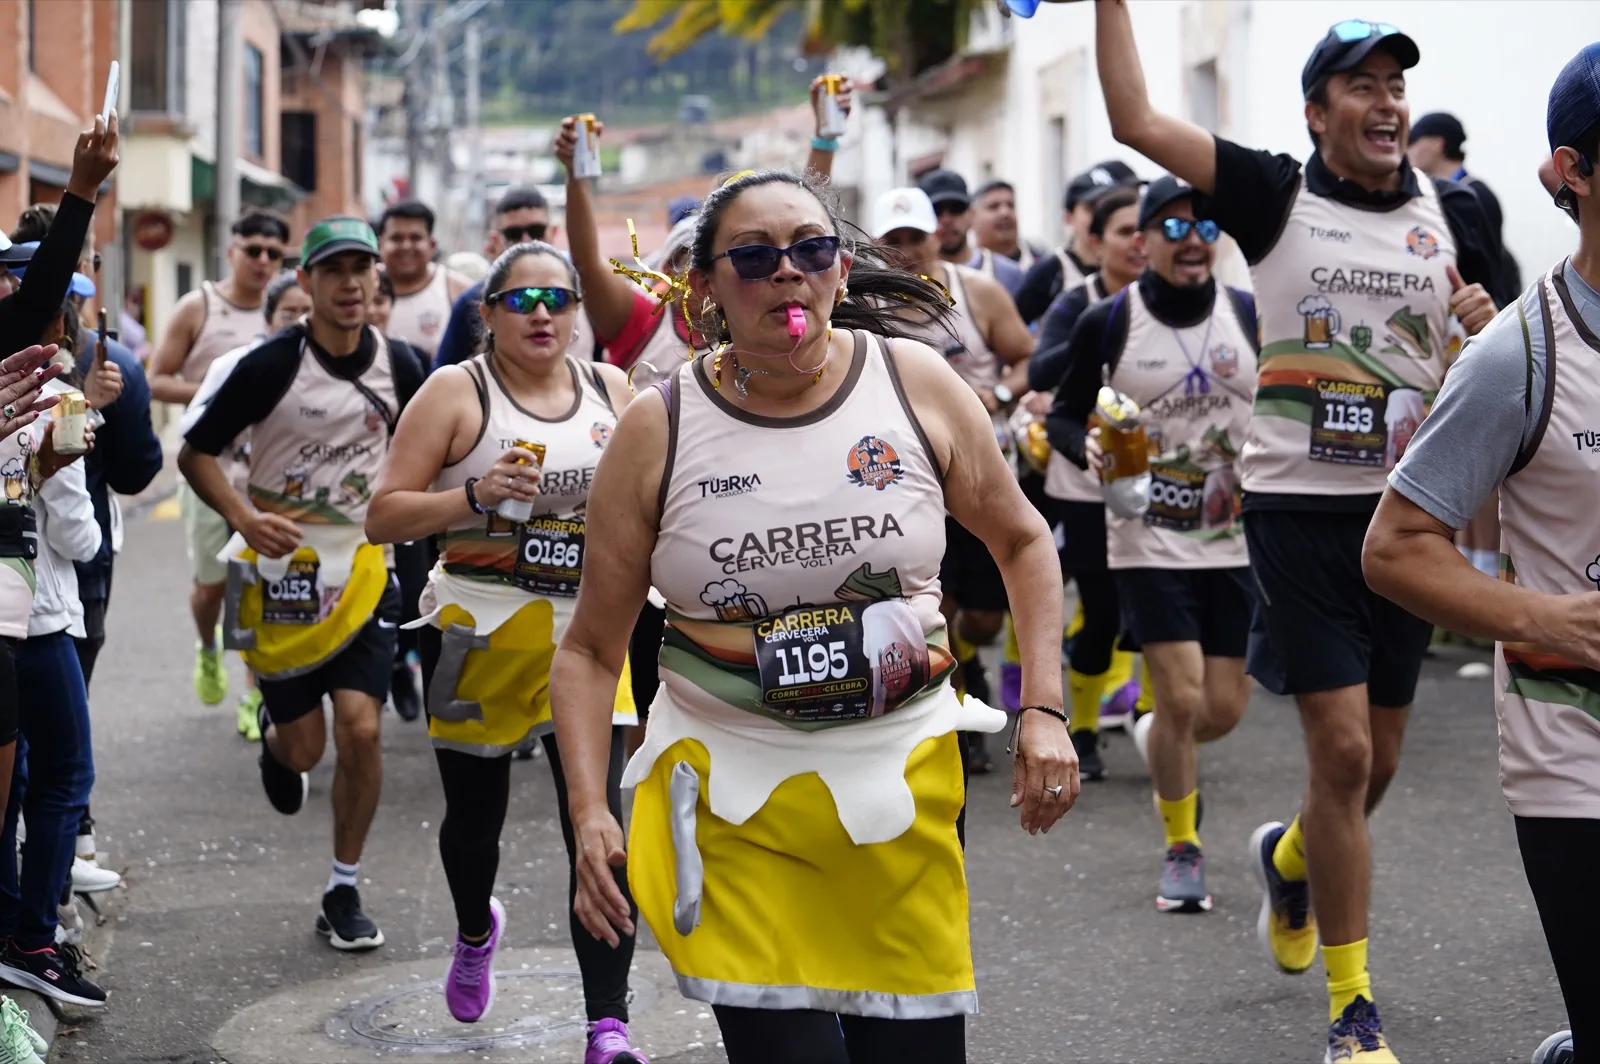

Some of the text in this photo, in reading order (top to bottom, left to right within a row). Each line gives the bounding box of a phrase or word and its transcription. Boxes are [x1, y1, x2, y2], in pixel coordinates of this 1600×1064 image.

[1310, 266, 1435, 293] CARRERA
[1317, 381, 1385, 399] CARRERA
[1323, 403, 1374, 433] 1133
[524, 538, 580, 568] 0186
[709, 513, 905, 563] CARRERA
[722, 541, 857, 575] CERVECERA
[800, 557, 833, 569] VOL 1
[268, 579, 312, 600] 0152
[757, 606, 855, 637] CARRERA
[764, 625, 829, 644] CERVECERA
[775, 640, 849, 686] 1195
